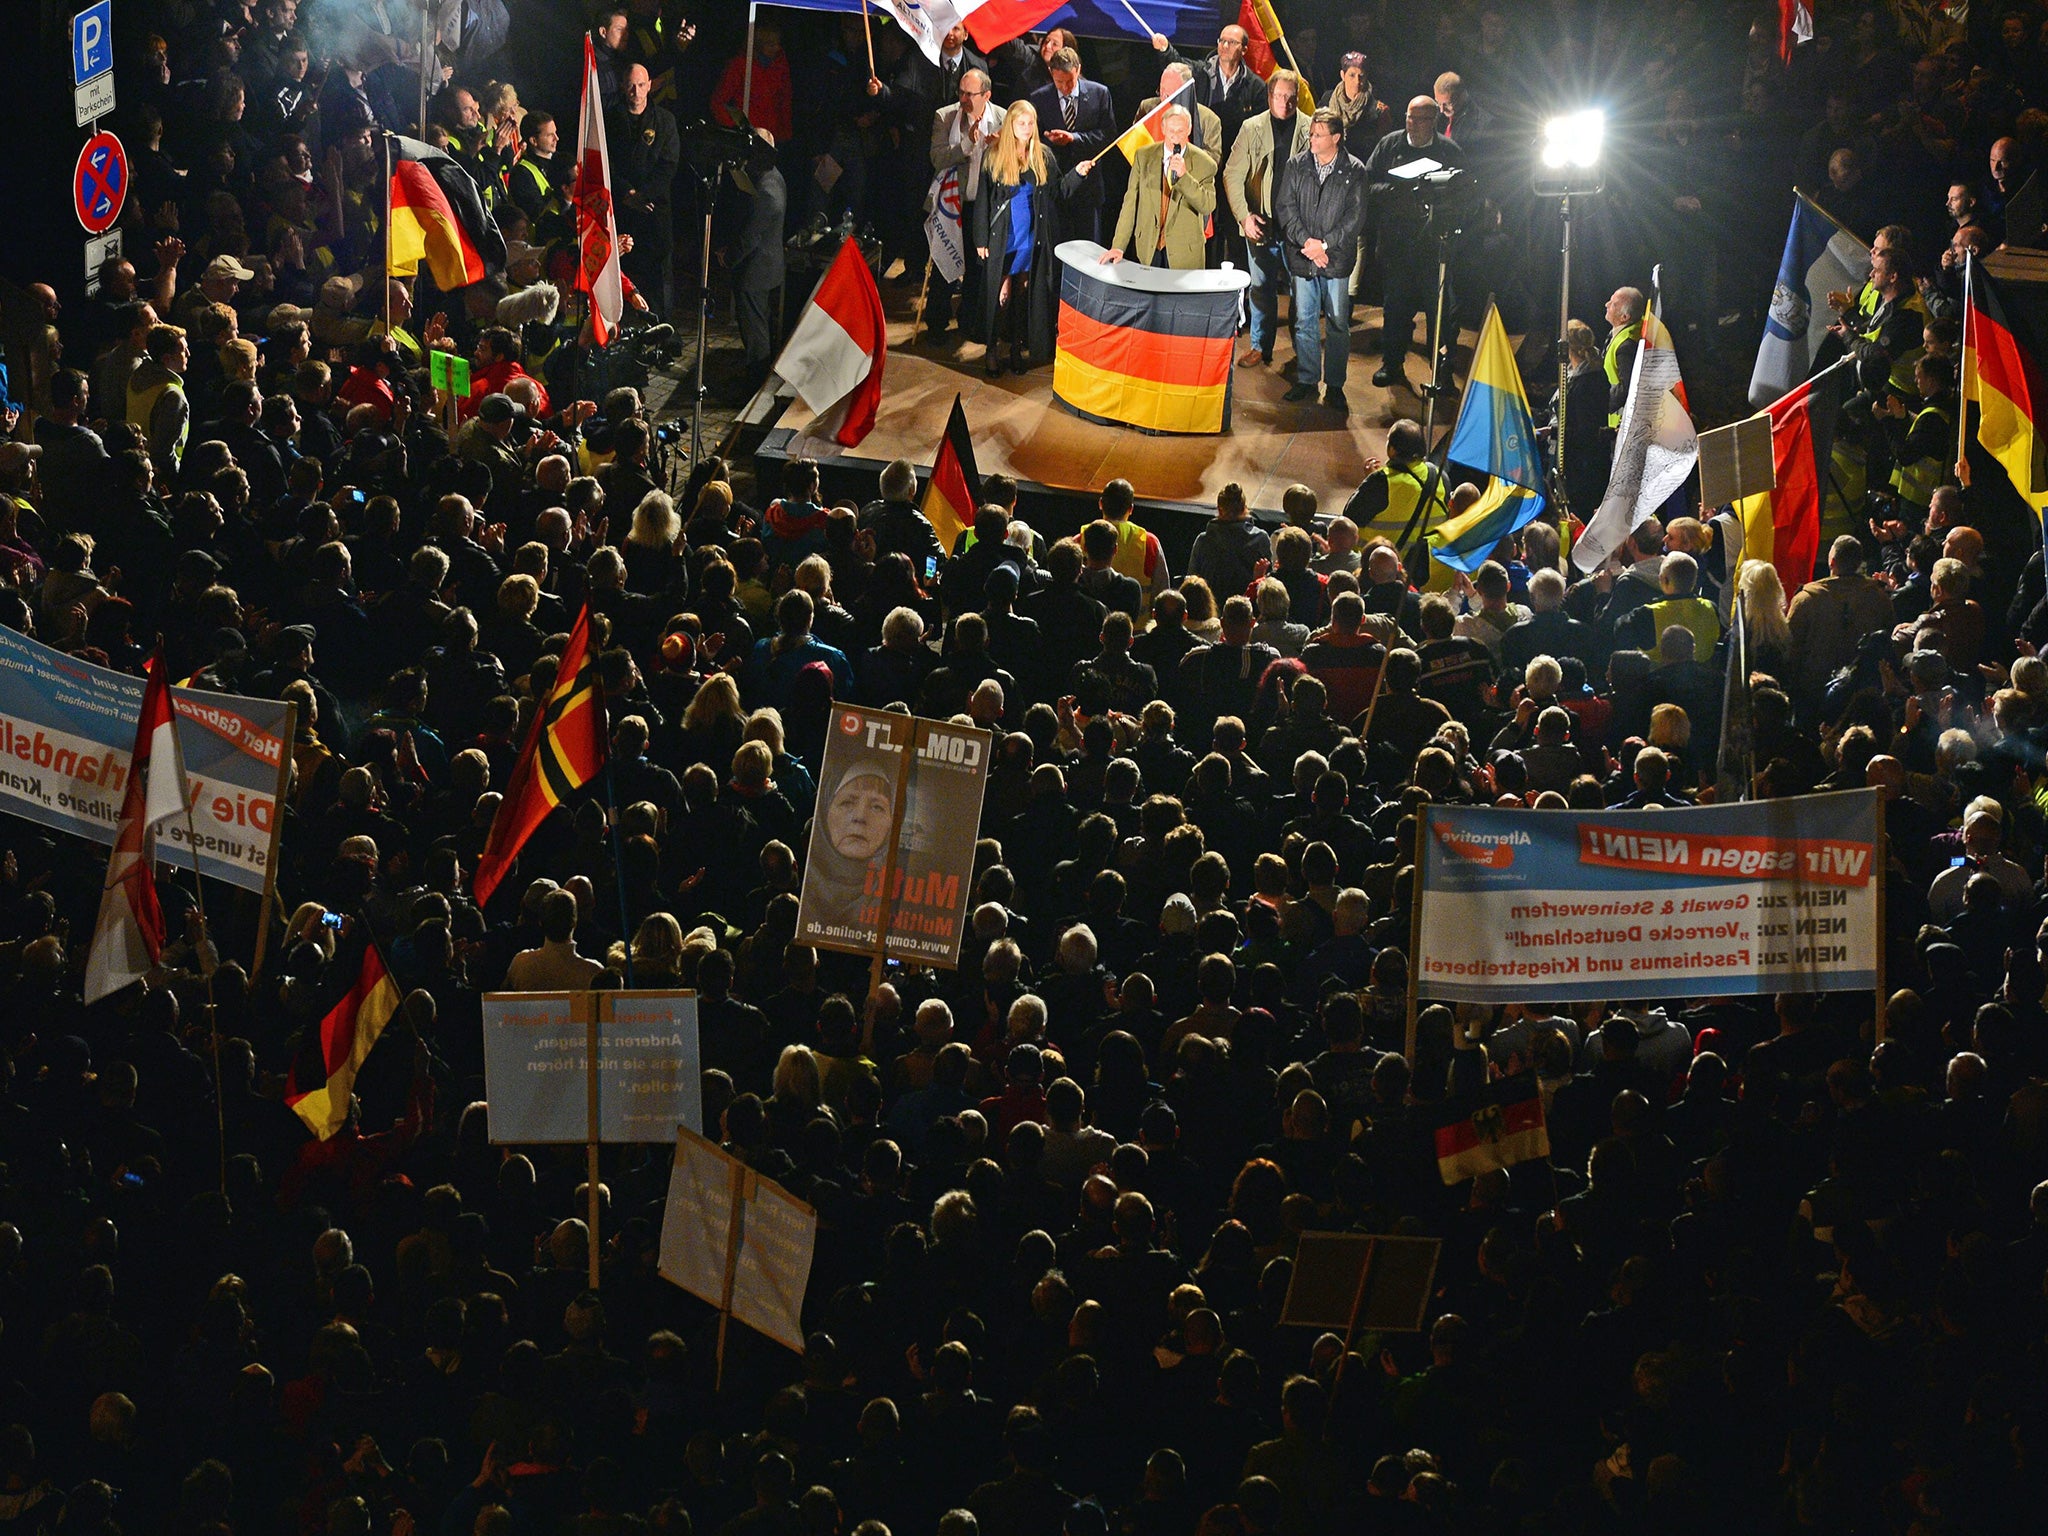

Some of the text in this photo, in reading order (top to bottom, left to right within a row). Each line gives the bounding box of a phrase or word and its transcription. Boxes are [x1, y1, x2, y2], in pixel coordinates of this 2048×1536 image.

[82, 15, 102, 72] P
[89, 83, 101, 99] mit
[79, 94, 112, 117] Parkschein
